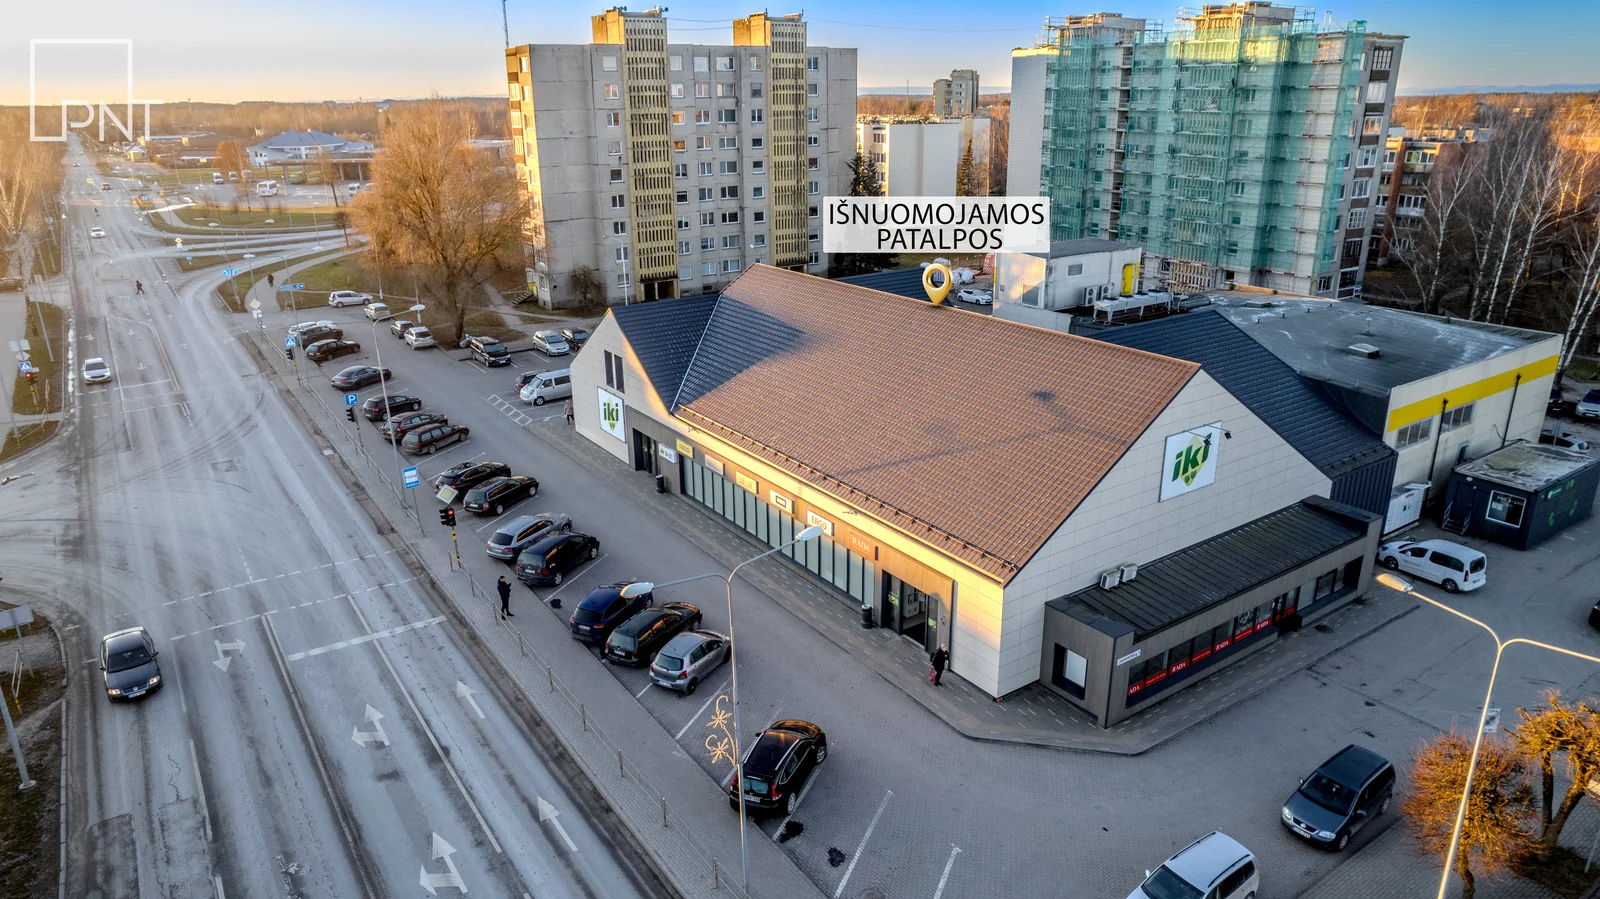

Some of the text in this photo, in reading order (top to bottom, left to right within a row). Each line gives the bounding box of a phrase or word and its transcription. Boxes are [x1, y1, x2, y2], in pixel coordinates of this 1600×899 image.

[603, 402, 619, 422] iki
[1172, 432, 1212, 482] iki
[811, 515, 828, 530] ERGO
[852, 536, 870, 553] RADA
